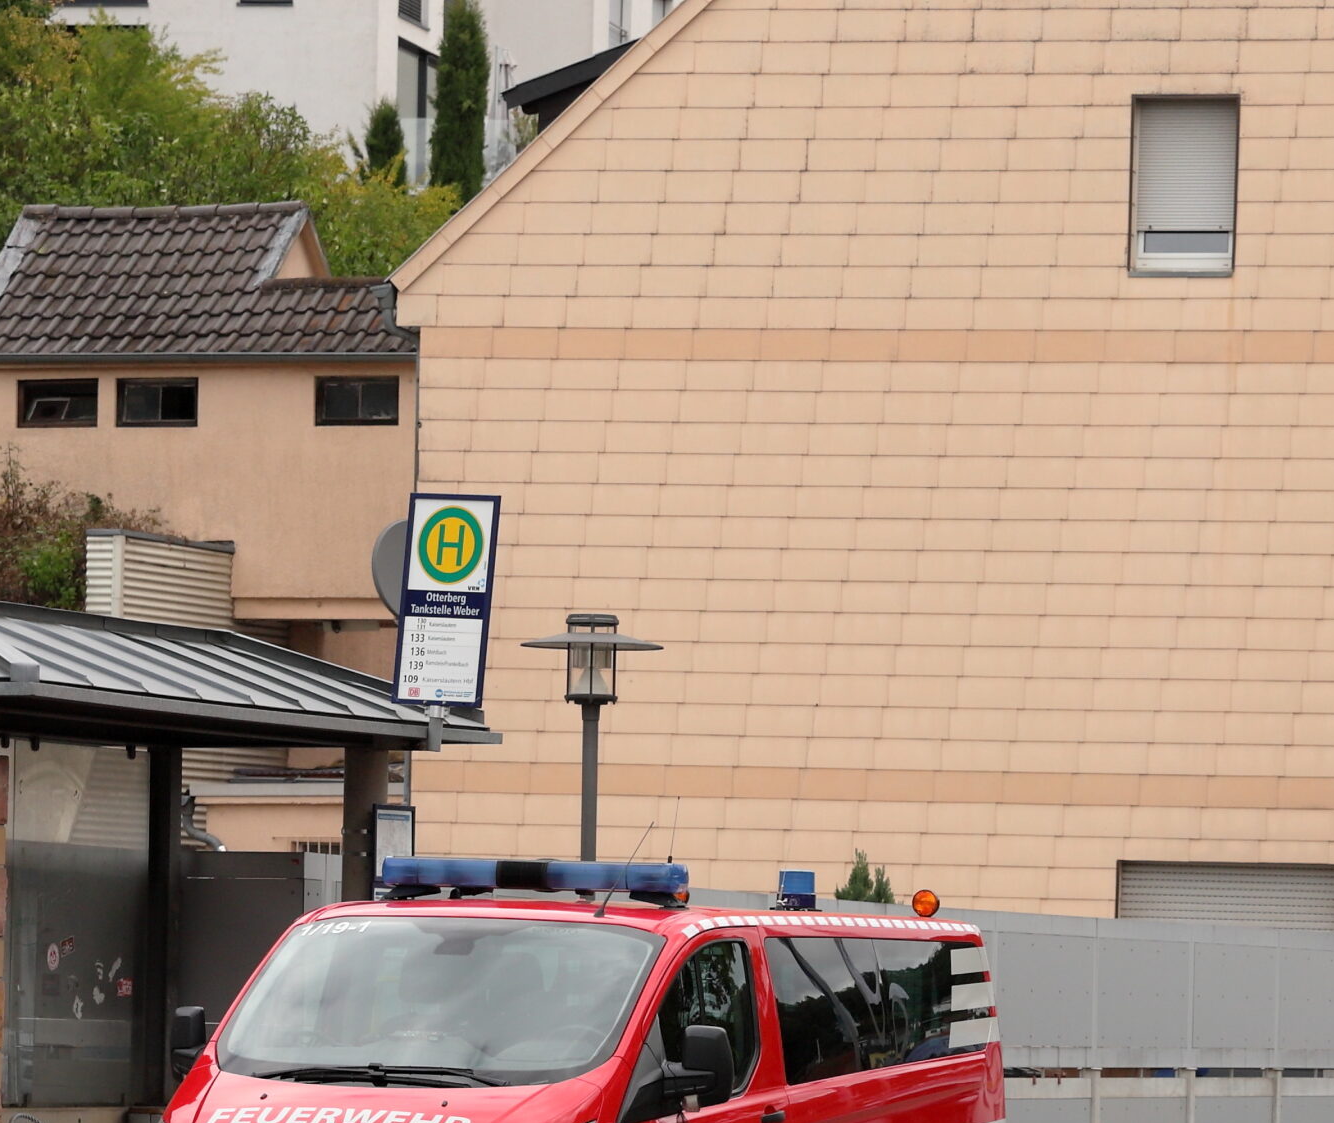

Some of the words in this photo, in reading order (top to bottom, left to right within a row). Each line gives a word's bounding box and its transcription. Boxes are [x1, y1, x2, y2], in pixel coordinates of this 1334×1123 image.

[436, 524, 465, 566] H
[426, 592, 467, 605] Otterberg
[411, 604, 452, 615] Tankstelle
[453, 606, 480, 616] Weber
[411, 633, 425, 642] 133
[411, 647, 425, 656] 136
[409, 661, 424, 670] 139
[403, 675, 418, 683] 109
[300, 920, 372, 937] 1/19-1
